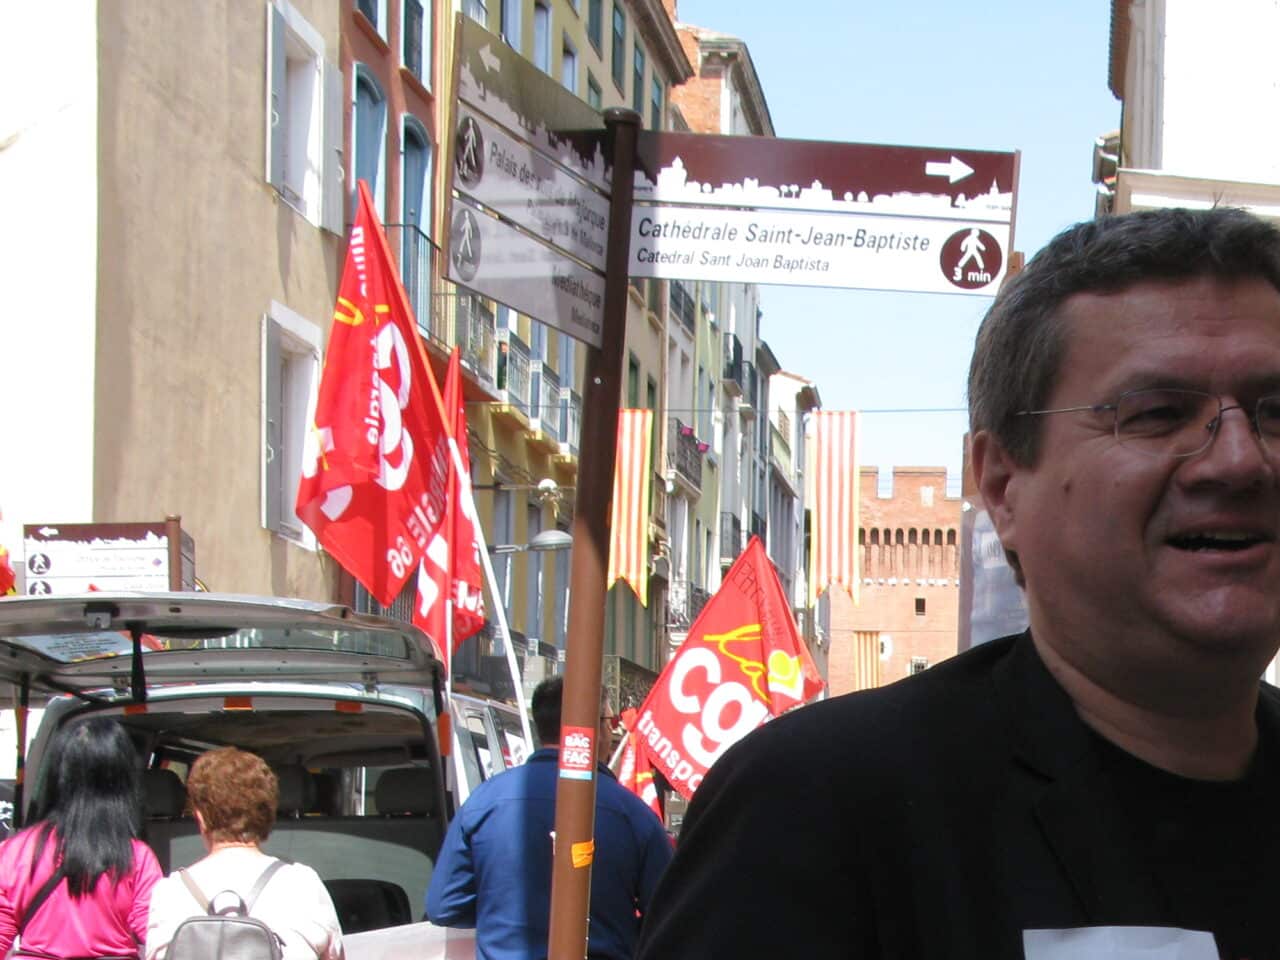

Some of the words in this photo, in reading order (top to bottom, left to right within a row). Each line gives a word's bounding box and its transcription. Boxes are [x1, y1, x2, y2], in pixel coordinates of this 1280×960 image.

[489, 141, 518, 178] Palais
[638, 218, 738, 242] Cathédrale
[745, 224, 931, 253] Saint-Jean-Baptiste
[636, 248, 695, 265] Catedral
[699, 251, 731, 267] Sant
[736, 253, 769, 269] Joan
[773, 255, 830, 273] Baptista
[953, 268, 963, 281] 3
[967, 270, 991, 282] min
[637, 710, 704, 792] transpo
